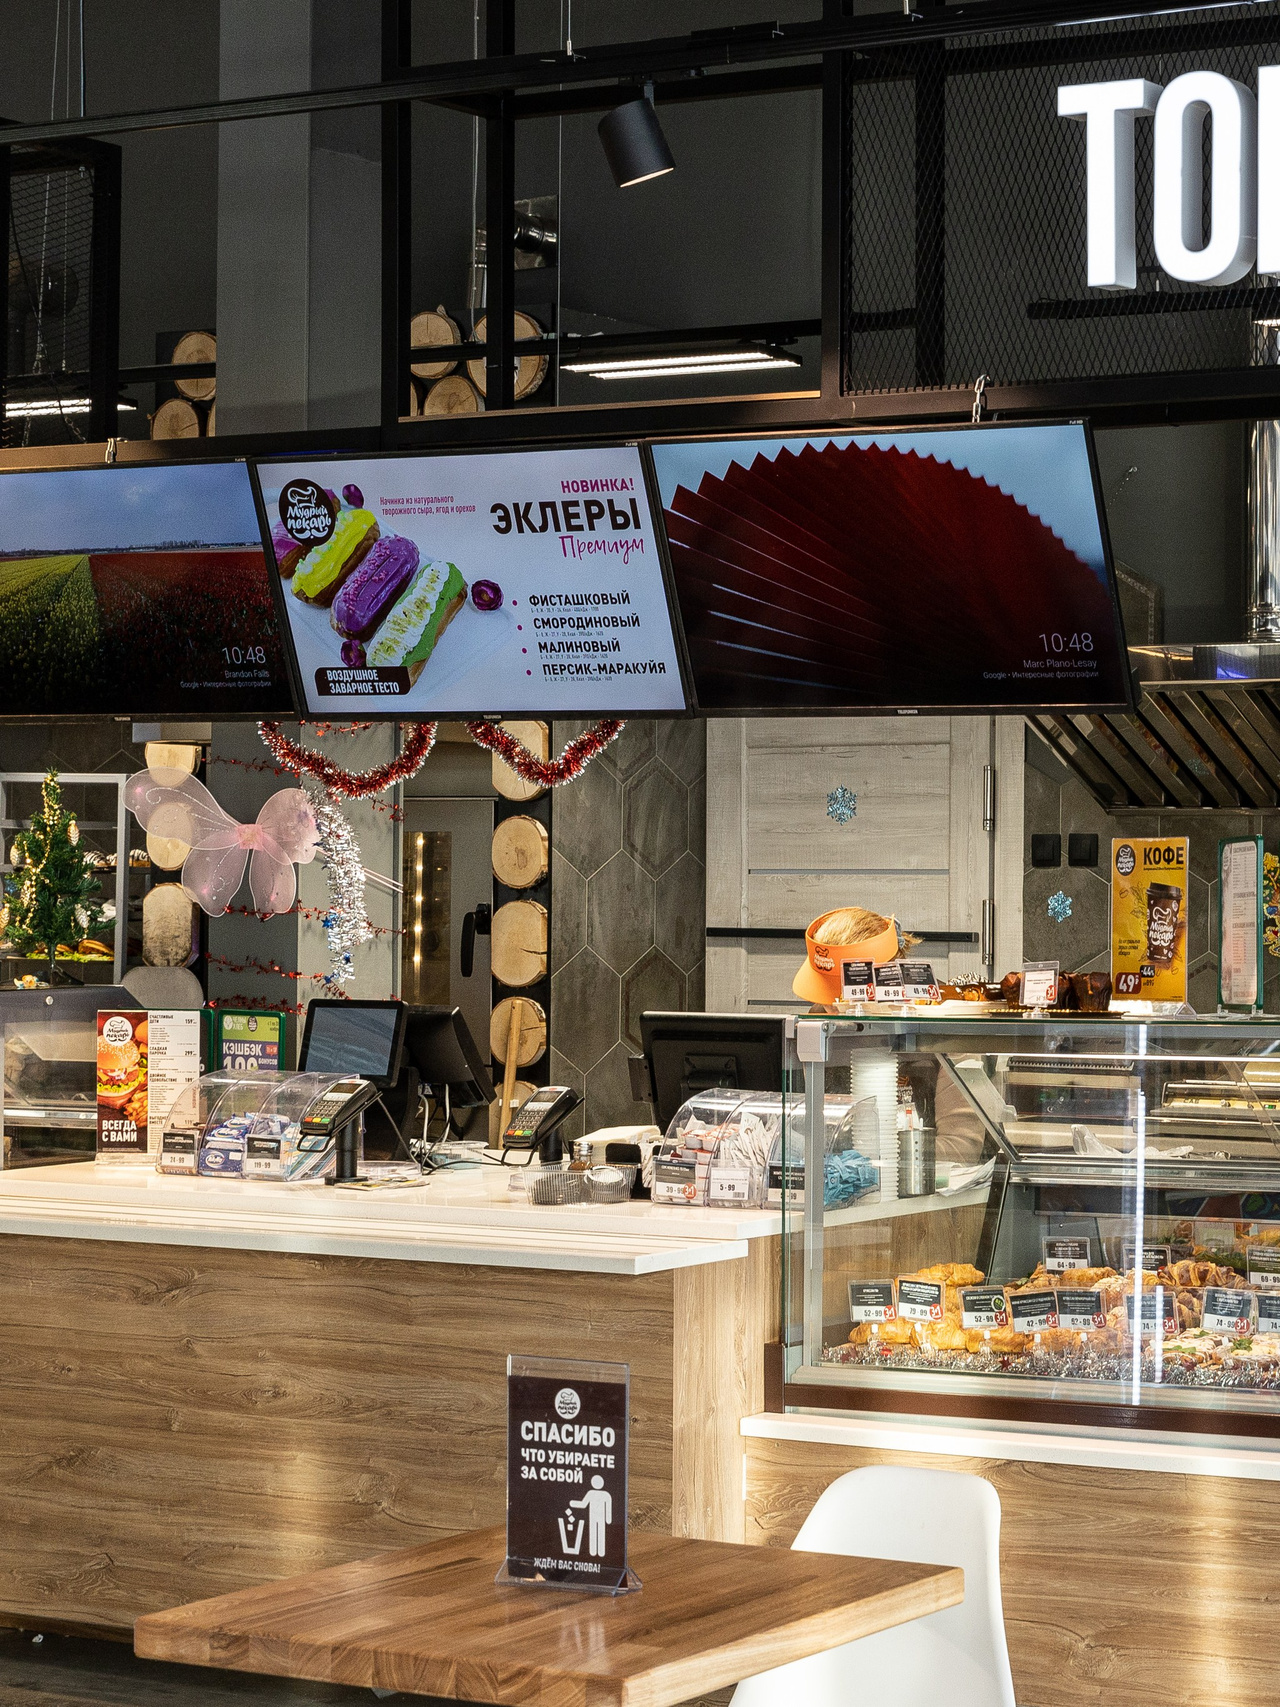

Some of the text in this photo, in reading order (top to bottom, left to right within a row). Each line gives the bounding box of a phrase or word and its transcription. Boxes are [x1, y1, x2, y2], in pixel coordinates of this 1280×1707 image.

[561, 478, 634, 493] НОВИНКА!
[379, 497, 404, 505] Начинка
[414, 496, 454, 506] натурального
[287, 505, 328, 518] Мудрый
[382, 508, 416, 516] творожного
[436, 507, 449, 516] ягод
[456, 505, 476, 514] орехов
[490, 498, 641, 534] ЭКЛЕРЫ
[287, 517, 332, 530] пекарь
[559, 535, 644, 564] Премиум
[529, 590, 631, 606] ФИСТАШКОВЫЙ
[533, 613, 640, 630] СМОРОДИНОВЫЙ
[538, 638, 621, 653] МАЛИНОВЫЙ
[1038, 632, 1094, 652] 10:48
[222, 646, 266, 665] 10:48
[542, 660, 667, 676] ПЕРСИК-МАРАКУЙЯ
[1023, 660, 1045, 668] Marc
[225, 670, 270, 678] Brandon Falls
[326, 670, 379, 682] ВОЗДУШНОЕ
[983, 672, 1006, 680] Google
[1056, 671, 1098, 679] фотографии
[330, 682, 400, 694] ЗАВАРНОЕ ТЕСТО
[1143, 847, 1184, 866] КОФЕ
[1150, 932, 1174, 941] пекарь
[223, 1042, 262, 1056] КЭШБЭК
[102, 1120, 137, 1130] ВСЕГДА
[102, 1132, 137, 1142] С ВАМИ
[1236, 1320, 1247, 1330] 3+1
[520, 1420, 615, 1448] СПАСИБО
[520, 1448, 615, 1468] ЧТО УБИРАЕТЕ
[520, 1466, 583, 1484] ЗА СОБОЙ
[534, 1557, 601, 1573] ЖДЁМ ВАС СНОВА!
